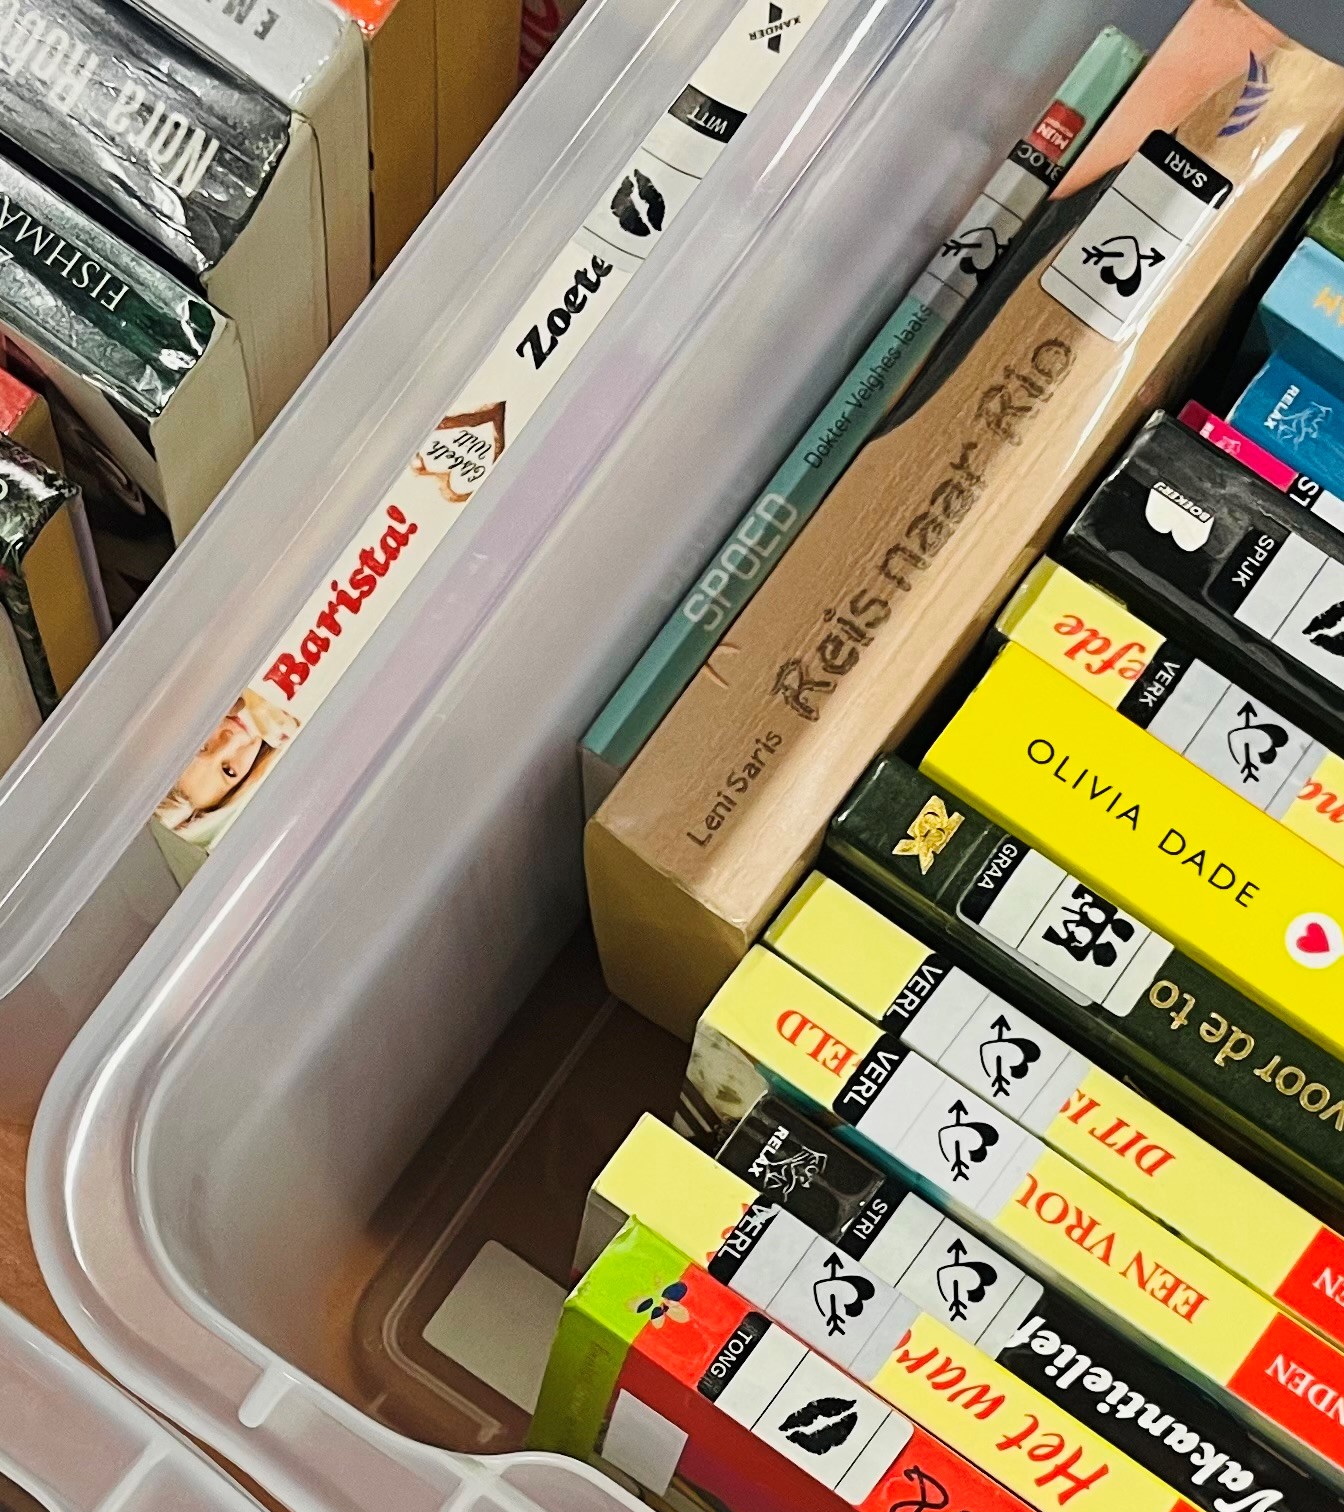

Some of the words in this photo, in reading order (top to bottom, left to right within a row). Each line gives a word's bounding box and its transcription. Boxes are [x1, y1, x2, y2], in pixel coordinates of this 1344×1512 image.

[92, 76, 225, 198] Nora
[687, 101, 729, 136] WITT
[1163, 149, 1211, 189] SARI
[802, 407, 856, 470] Dokter
[844, 341, 906, 415] Velghes
[1261, 382, 1301, 431] RELAX
[762, 571, 899, 728] Reis
[868, 432, 1006, 595] naar
[967, 318, 1085, 449] Rio
[679, 486, 804, 637] SPOED
[1229, 530, 1276, 588] SPIJK
[260, 500, 423, 704] Barista!
[1137, 655, 1181, 709] VERK
[685, 788, 739, 850] Leni
[723, 723, 786, 798] Saris
[1021, 731, 1147, 831] OLIVIA
[1155, 823, 1260, 909] DADE
[975, 839, 1020, 893] GRAA
[883, 955, 944, 1027] VERL
[1187, 1007, 1258, 1075] de
[840, 1042, 899, 1113] VERL
[746, 1123, 790, 1177] RELAX
[1087, 1106, 1176, 1182] DIT
[851, 1194, 890, 1240] STRI
[1120, 1247, 1209, 1323] EEN
[708, 1326, 753, 1380] TONG
